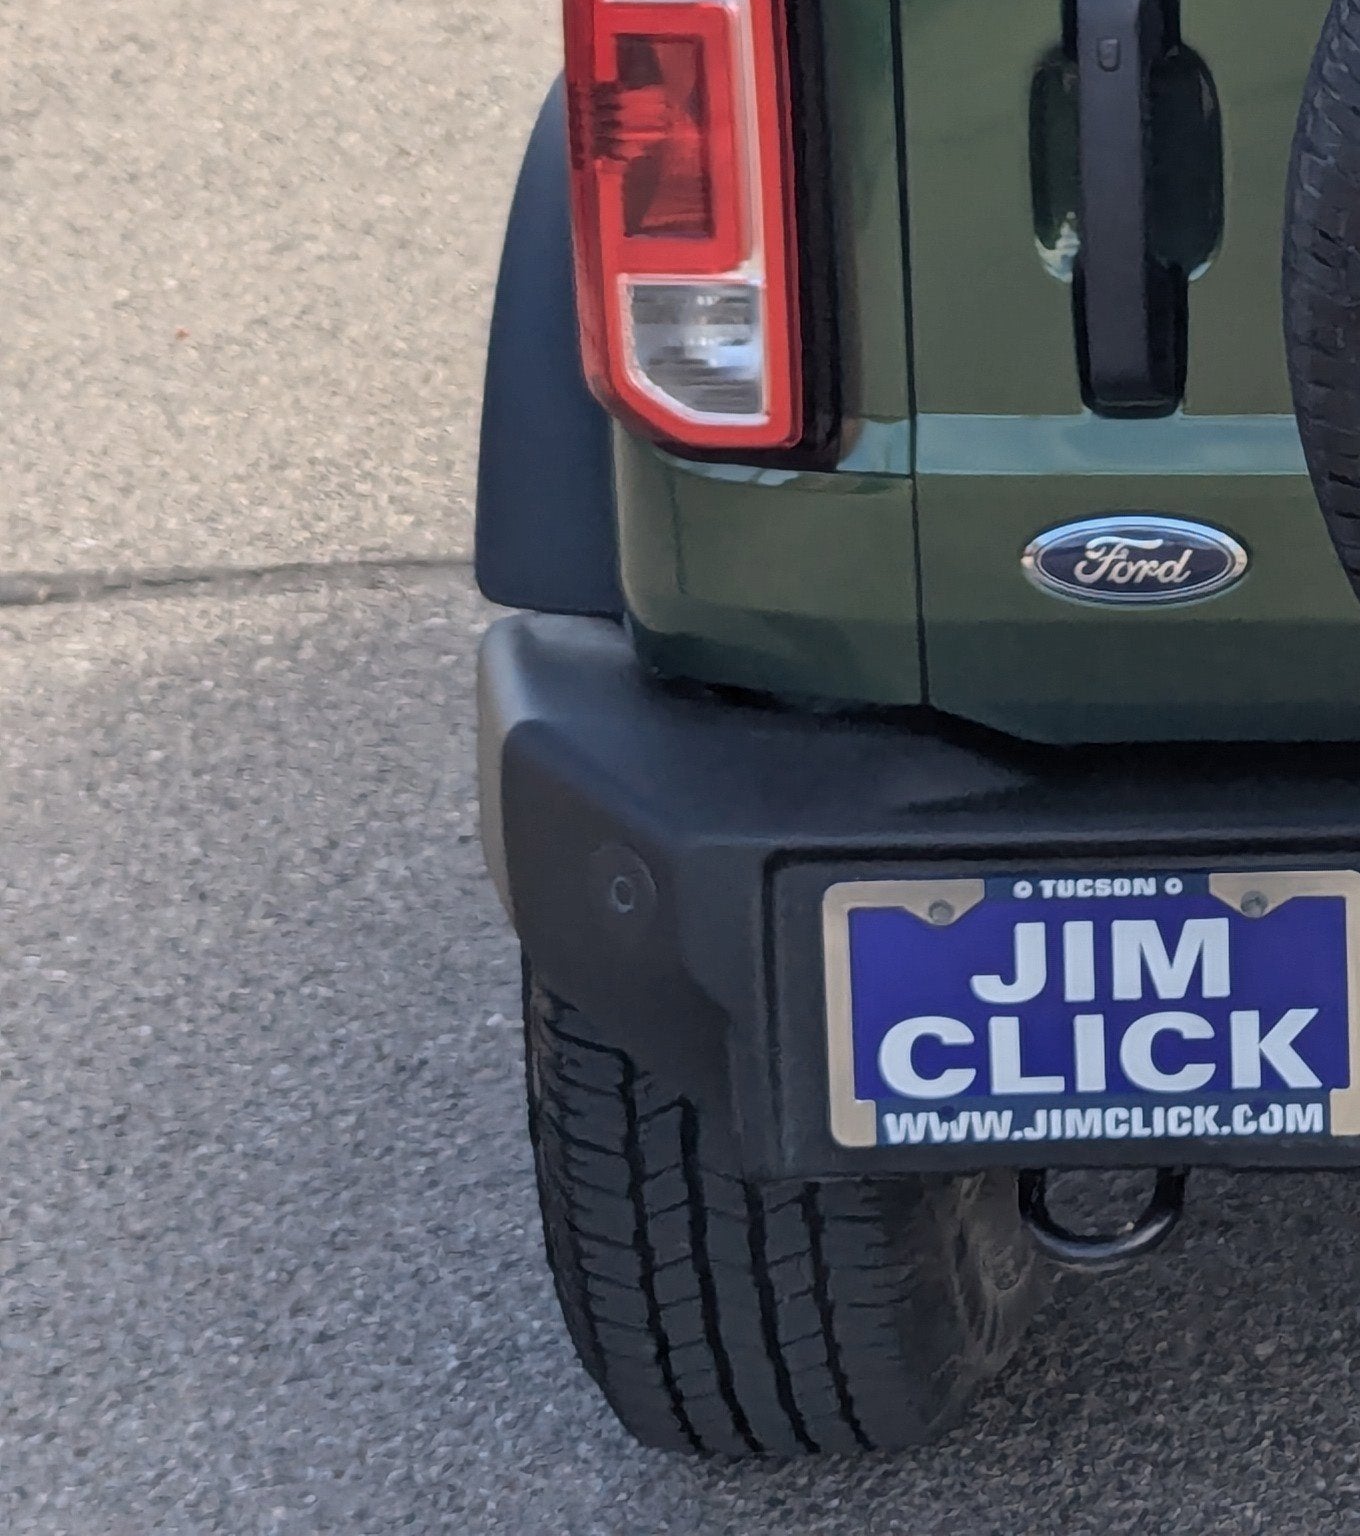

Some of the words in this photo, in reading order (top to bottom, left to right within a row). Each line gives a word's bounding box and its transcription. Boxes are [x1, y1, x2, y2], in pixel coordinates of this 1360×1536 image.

[1073, 536, 1193, 584] Ford
[1040, 877, 1157, 900] TUCSON
[970, 917, 1231, 1003] JIM
[877, 1007, 1323, 1099] CLICK
[882, 1102, 1325, 1146] WWW.JIMCLICK.COM
